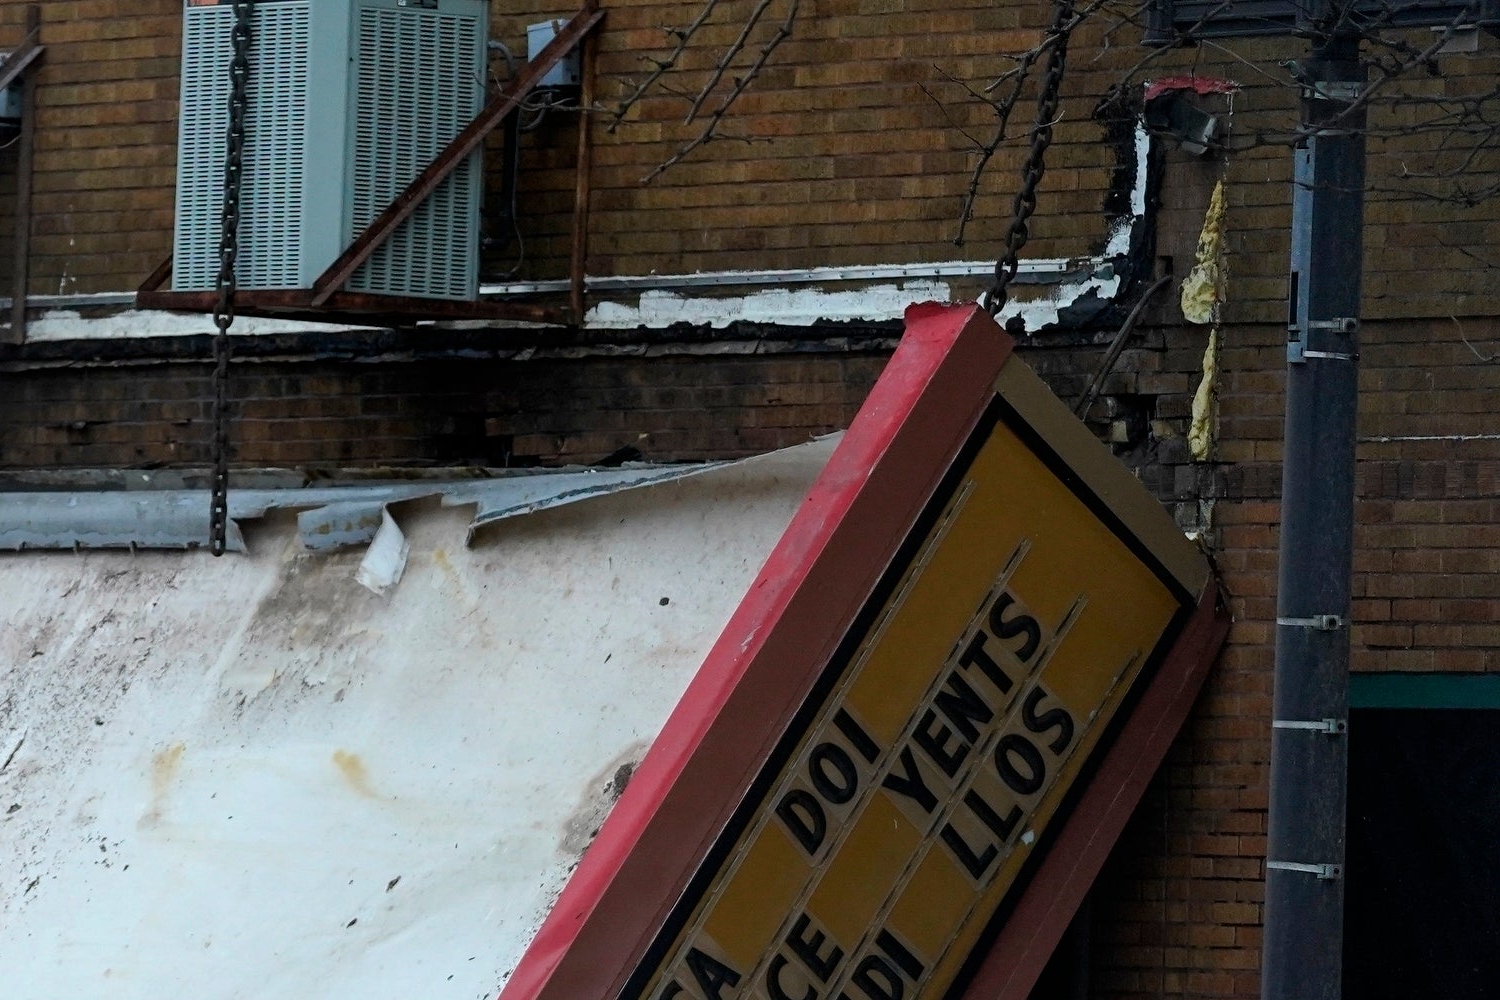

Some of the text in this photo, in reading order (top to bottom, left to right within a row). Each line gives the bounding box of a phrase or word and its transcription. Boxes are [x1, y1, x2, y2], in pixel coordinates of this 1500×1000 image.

[775, 708, 881, 857] DOI
[882, 592, 1041, 816] YENTS
[939, 685, 1075, 881] LLOS
